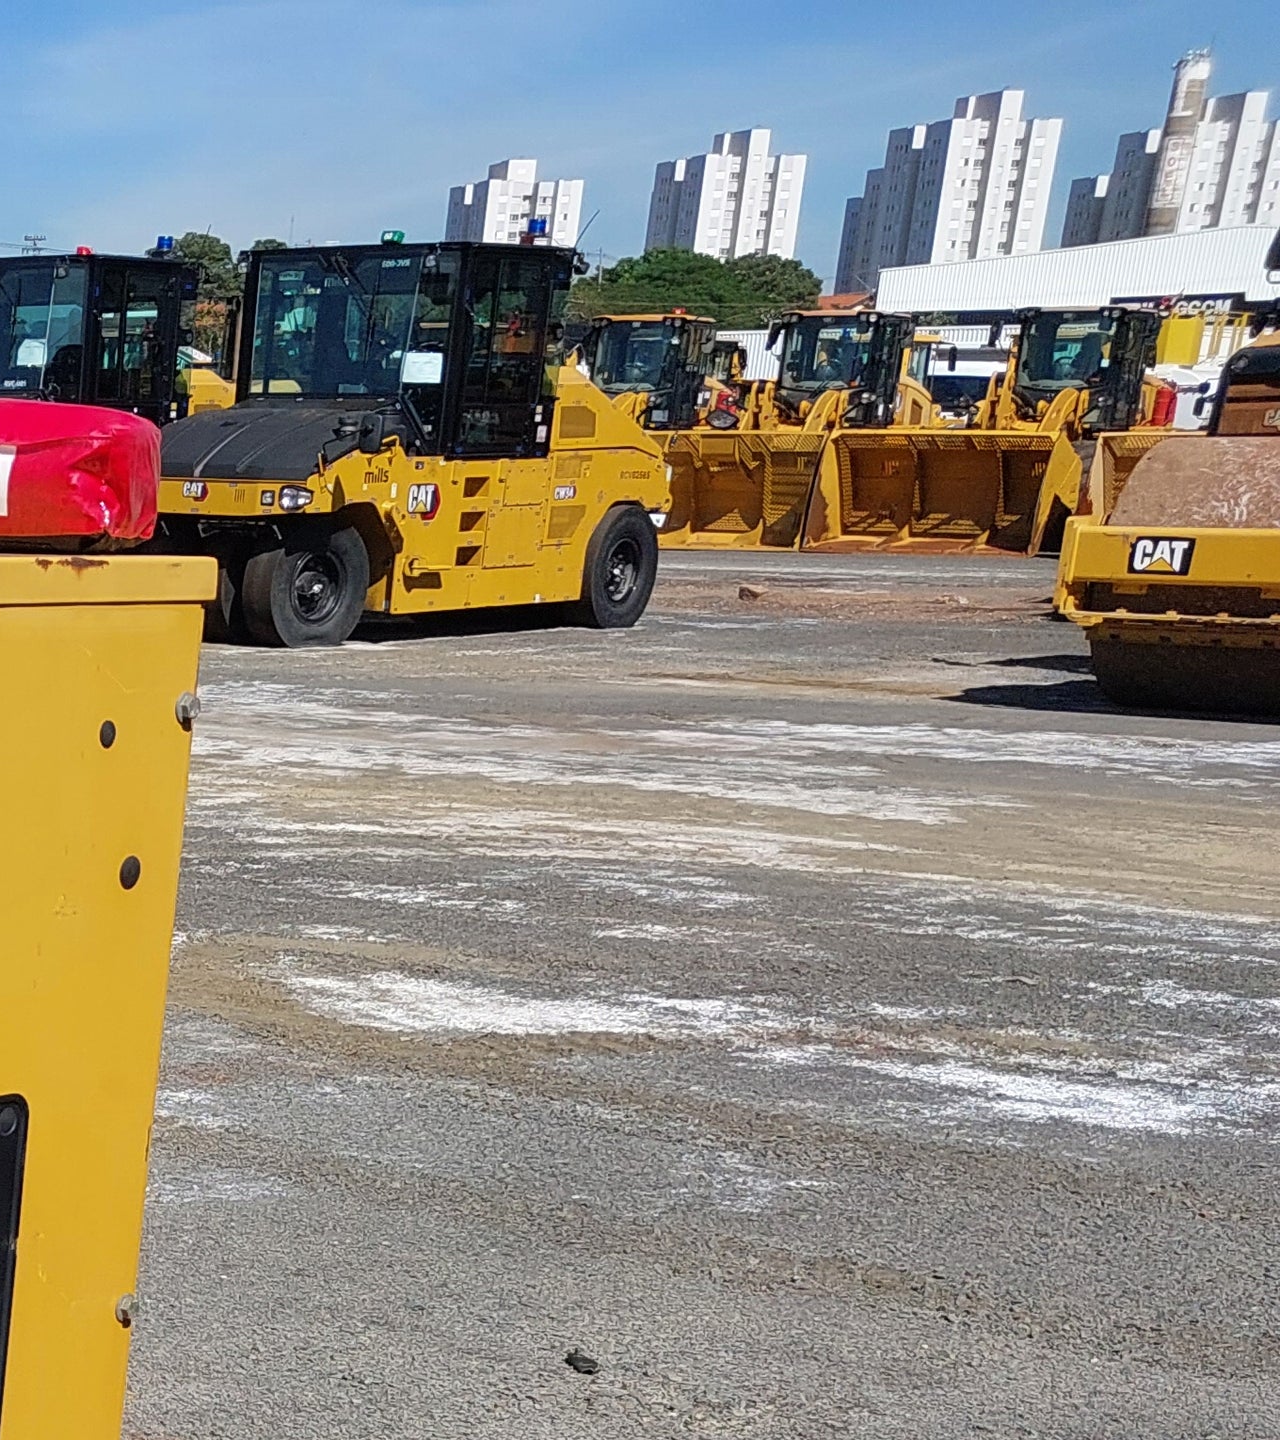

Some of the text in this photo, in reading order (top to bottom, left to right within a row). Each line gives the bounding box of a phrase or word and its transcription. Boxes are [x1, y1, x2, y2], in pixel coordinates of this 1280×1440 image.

[364, 466, 389, 484] mills
[183, 481, 204, 498] CAT
[408, 484, 436, 513] CAT
[1133, 540, 1190, 573] CAT
